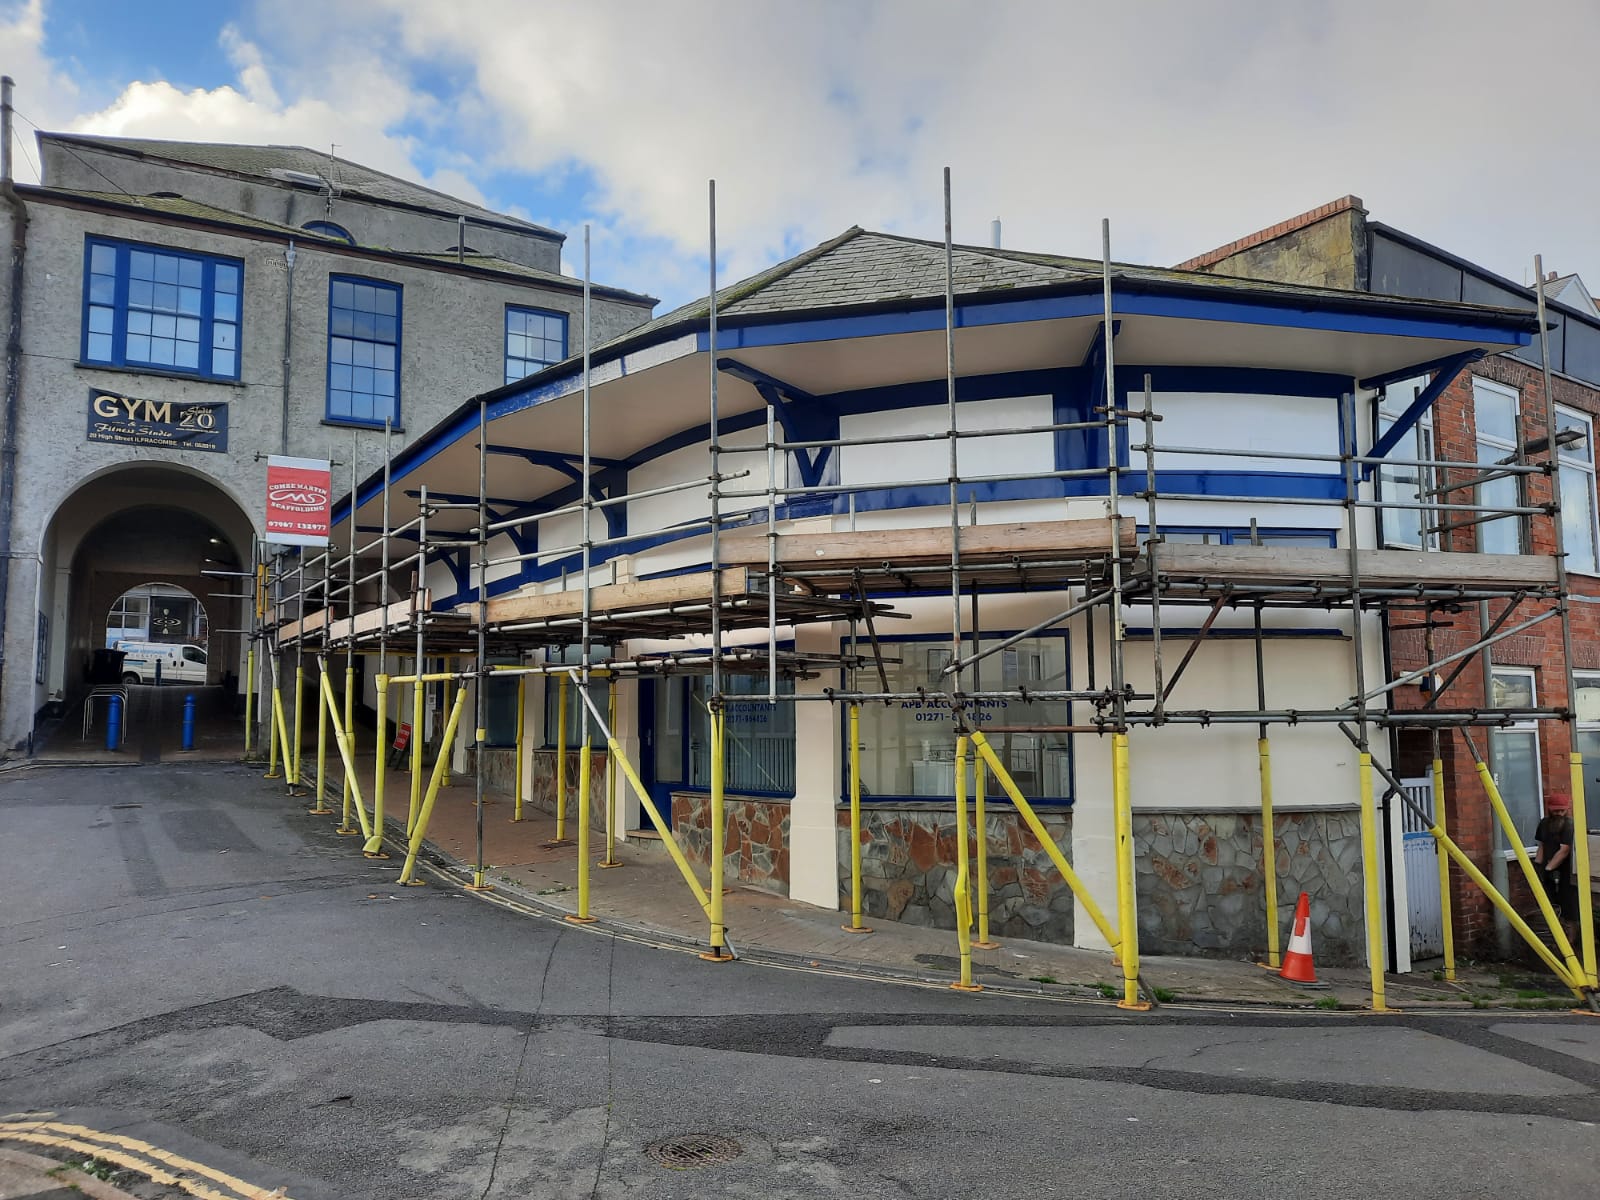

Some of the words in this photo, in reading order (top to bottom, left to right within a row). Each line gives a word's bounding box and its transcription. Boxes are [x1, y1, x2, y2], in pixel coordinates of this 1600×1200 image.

[94, 396, 171, 424] GYM
[179, 411, 215, 428] 20
[94, 422, 135, 433] Fitness
[136, 427, 173, 438] Studio
[98, 433, 113, 441] High
[114, 434, 133, 442] Street
[134, 436, 178, 446] ILFRACOMBE
[297, 484, 327, 495] MARTIN
[271, 502, 324, 512] SCAFFOLDING
[901, 701, 922, 709] APB
